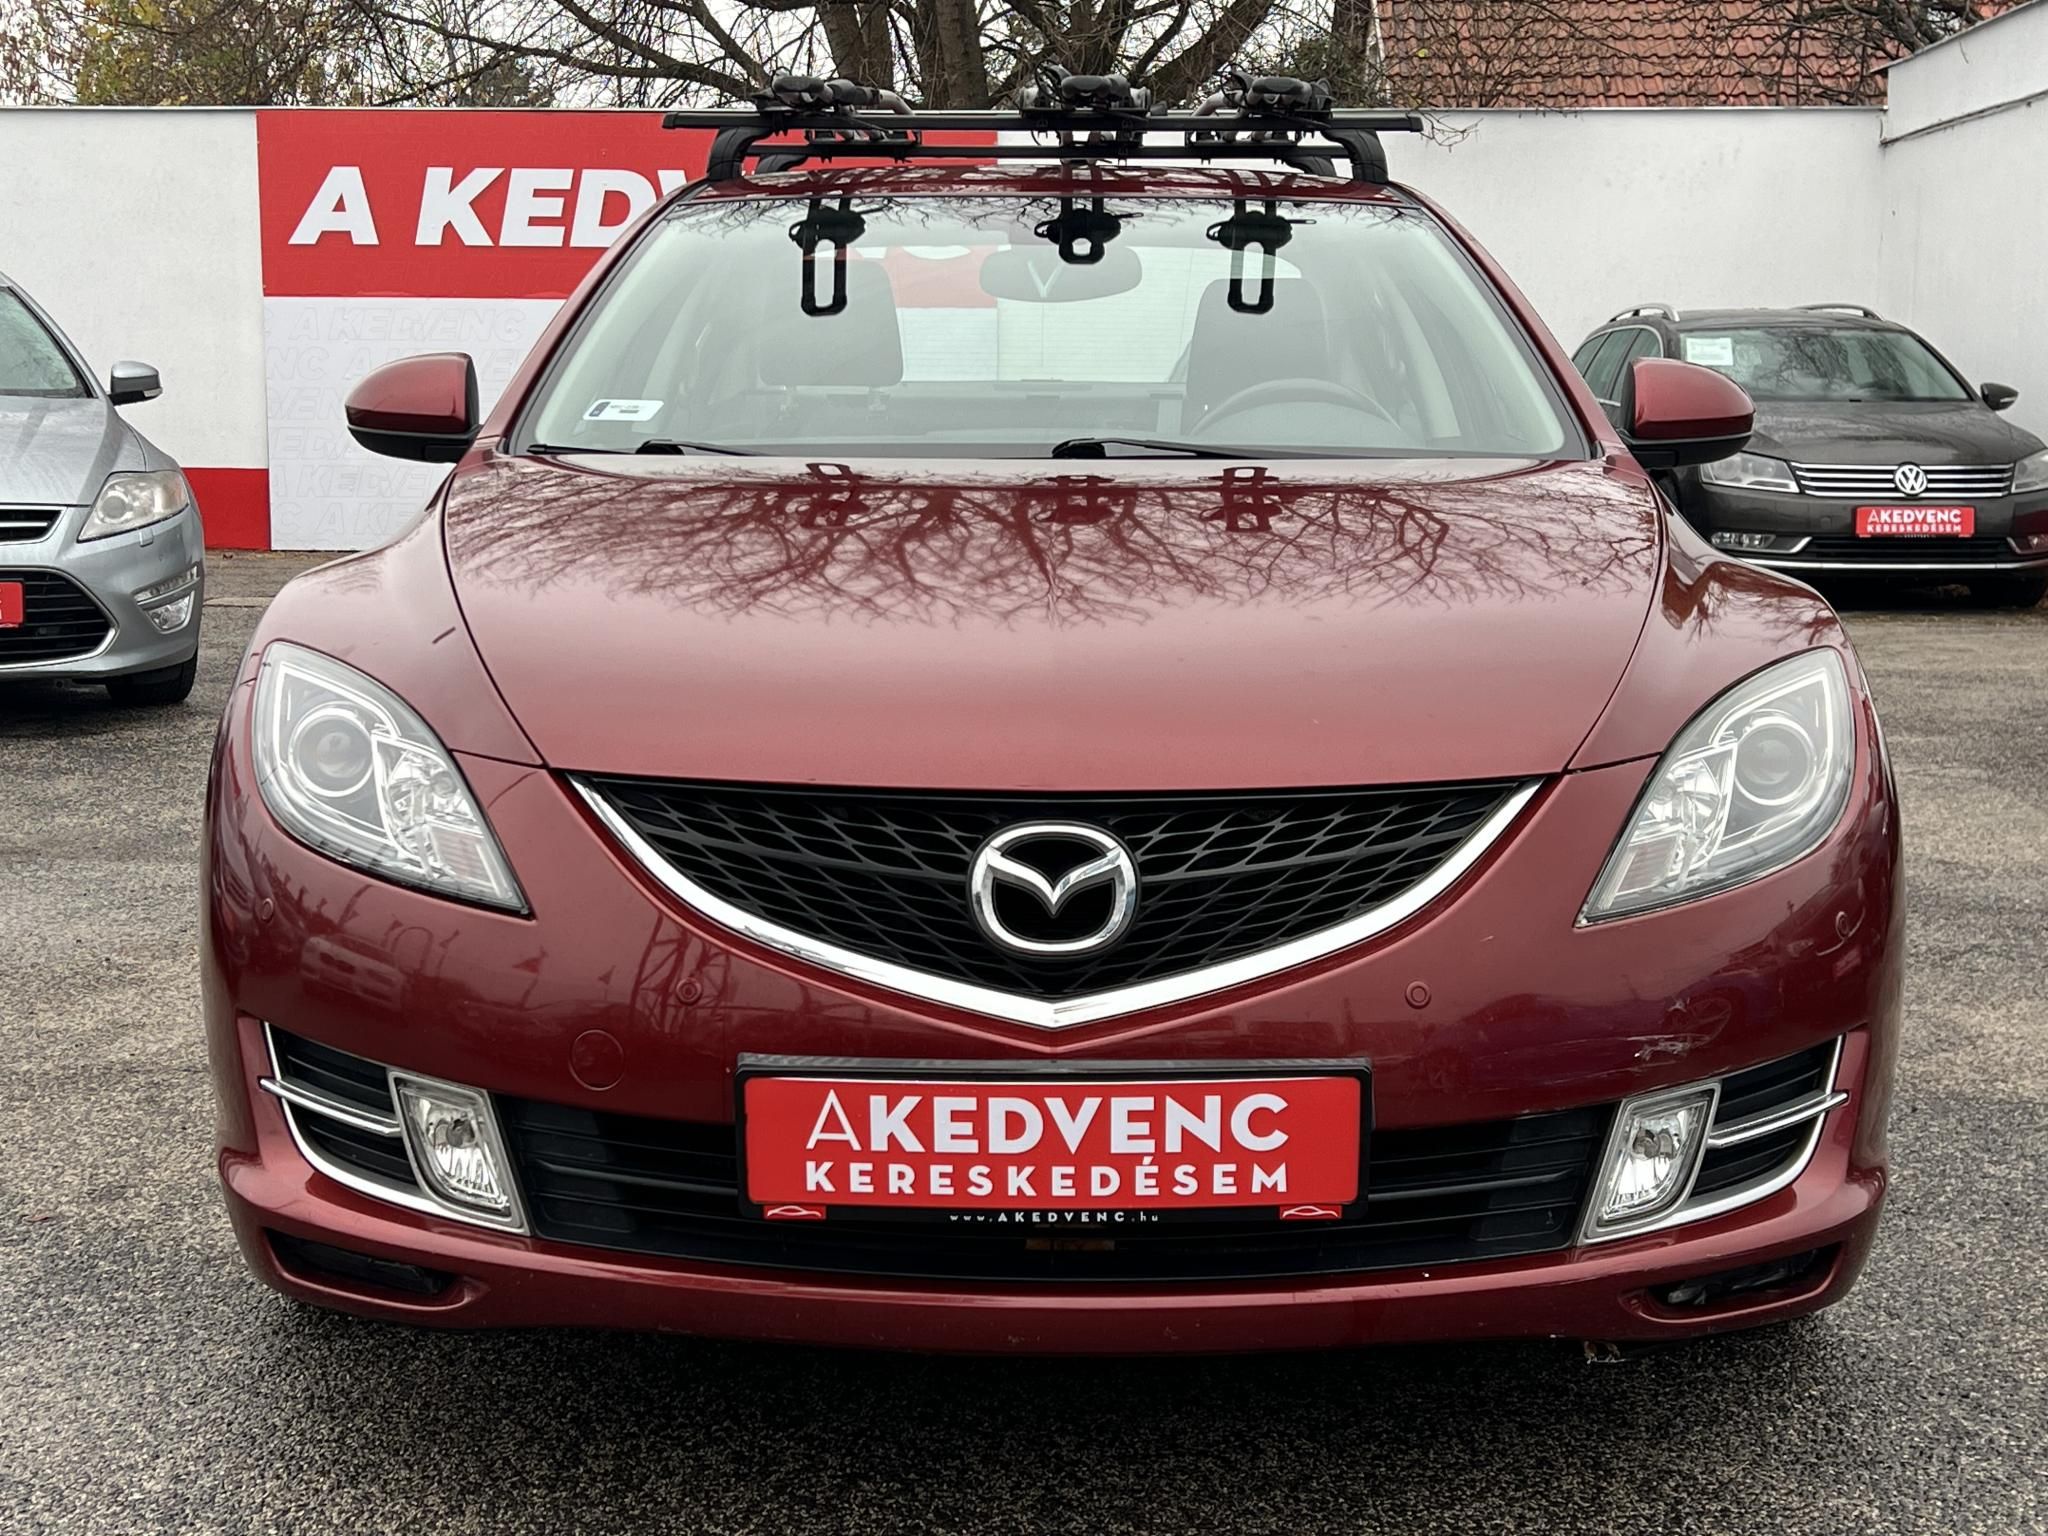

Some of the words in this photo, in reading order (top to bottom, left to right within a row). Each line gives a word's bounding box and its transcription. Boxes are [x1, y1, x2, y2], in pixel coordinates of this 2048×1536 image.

[288, 166, 380, 245] A
[328, 307, 525, 341] KEDVENC
[806, 1157, 1288, 1197] KERESKEDÉSEM
[949, 1211, 1159, 1223] www.AKEDVENC.hu
